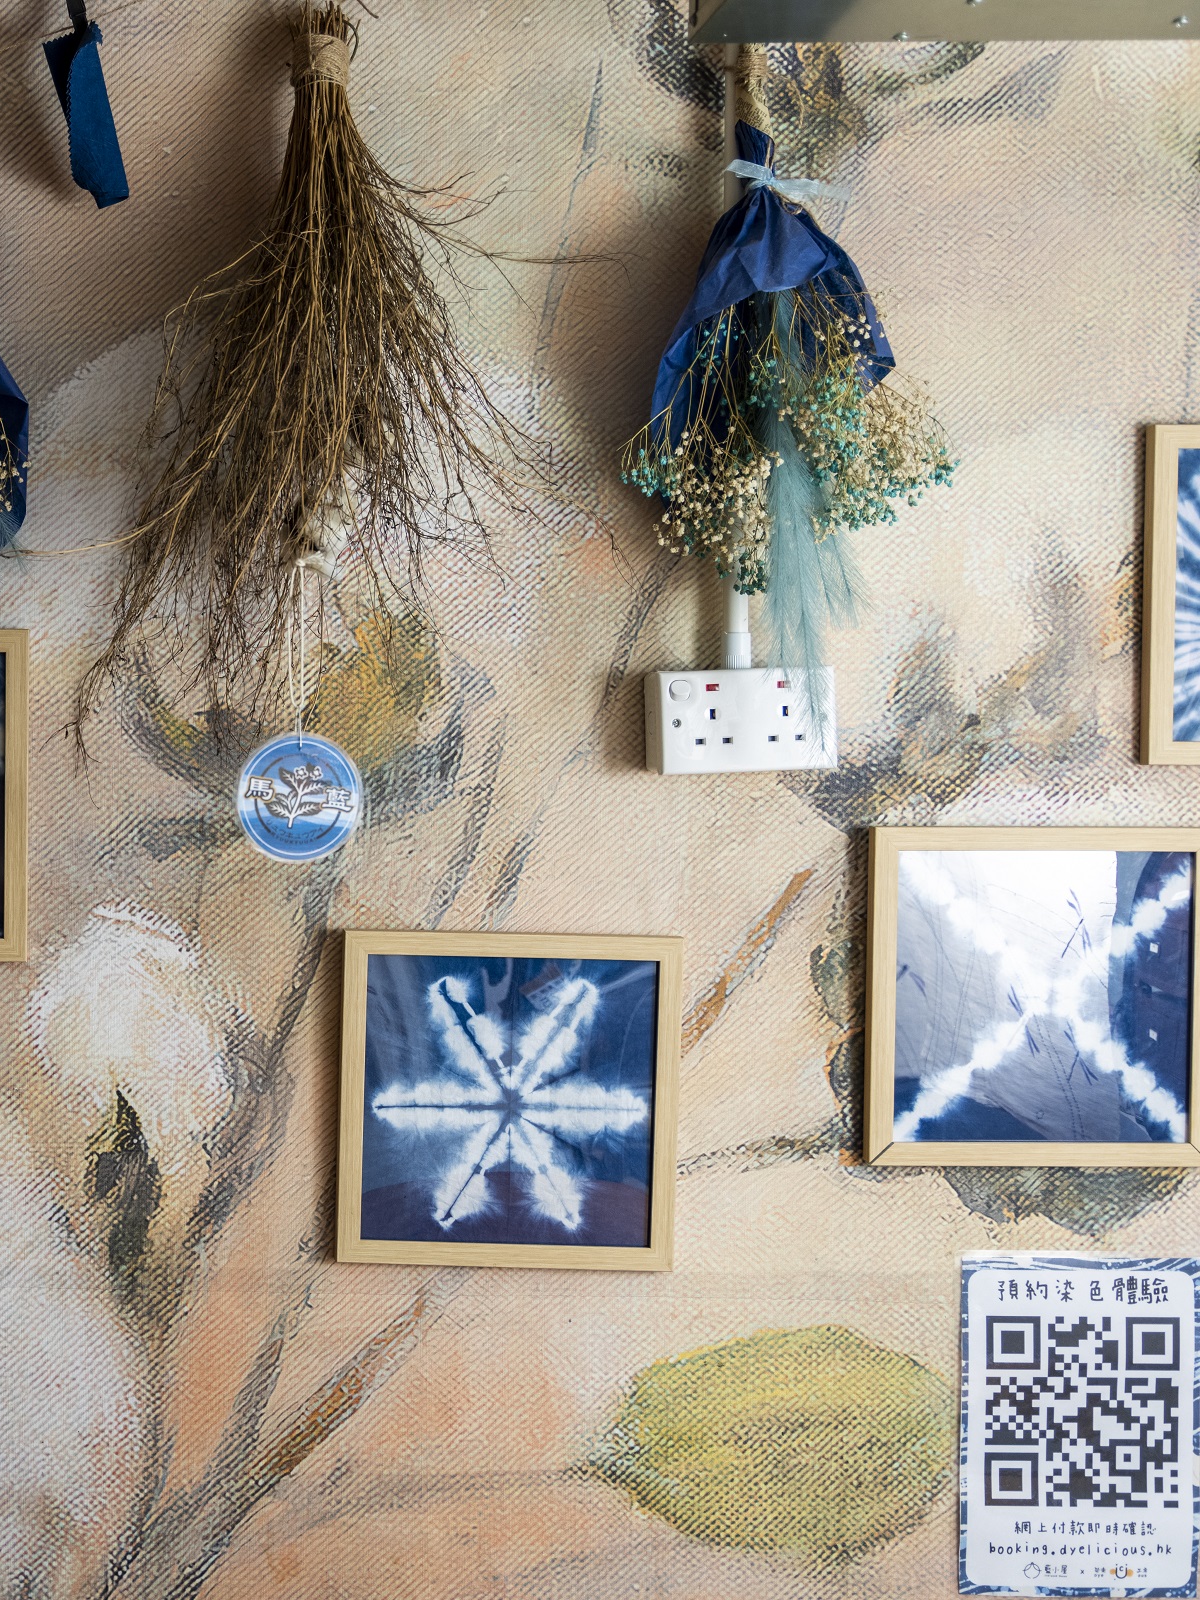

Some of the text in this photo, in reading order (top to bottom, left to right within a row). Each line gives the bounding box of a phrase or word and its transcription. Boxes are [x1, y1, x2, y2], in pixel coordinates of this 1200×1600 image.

[245, 777, 354, 812] 馬 藍
[997, 1276, 1169, 1305] 預約染色體驗
[1014, 1520, 1157, 1536] 網上付款即時確認
[989, 1541, 1172, 1557] booking.dyelicious.hk
